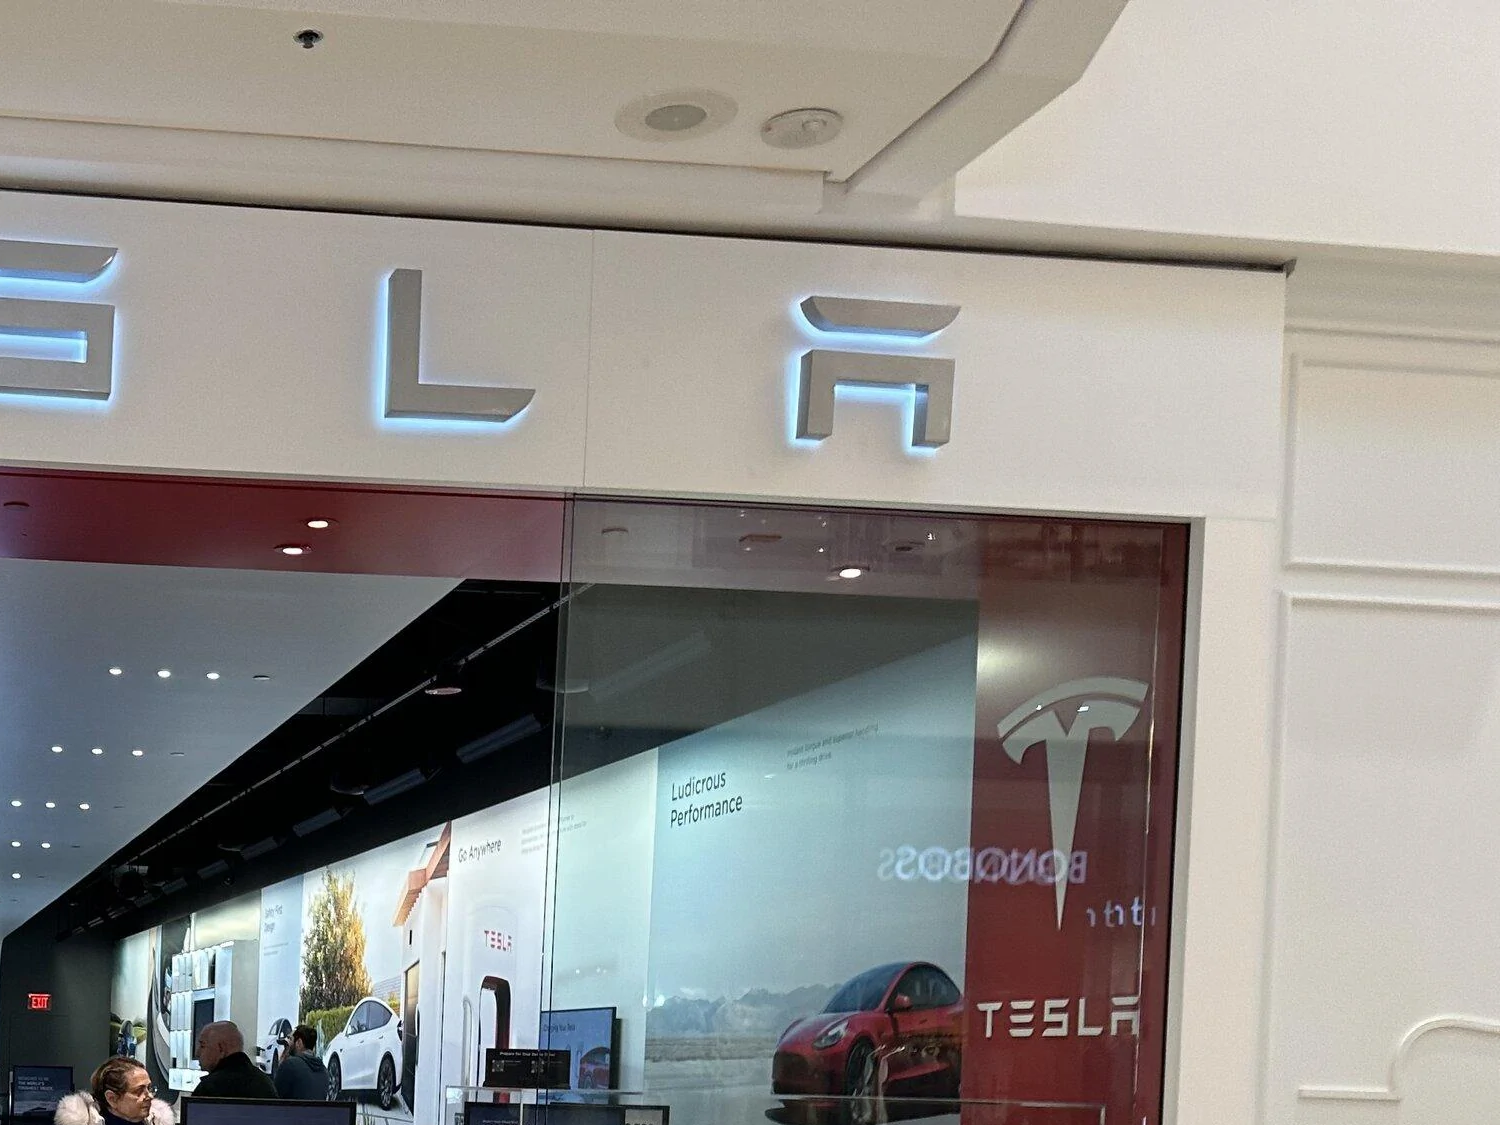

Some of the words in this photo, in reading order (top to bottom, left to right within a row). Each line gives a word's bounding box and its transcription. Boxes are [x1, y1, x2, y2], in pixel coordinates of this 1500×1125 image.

[672, 772, 726, 801] Ludicrous
[670, 795, 743, 829] Performance
[458, 848, 467, 863] Go
[469, 840, 502, 860] Anywhere
[484, 930, 512, 953] TESLA
[31, 997, 48, 1009] EXIT
[976, 996, 1140, 1038] TESLA
